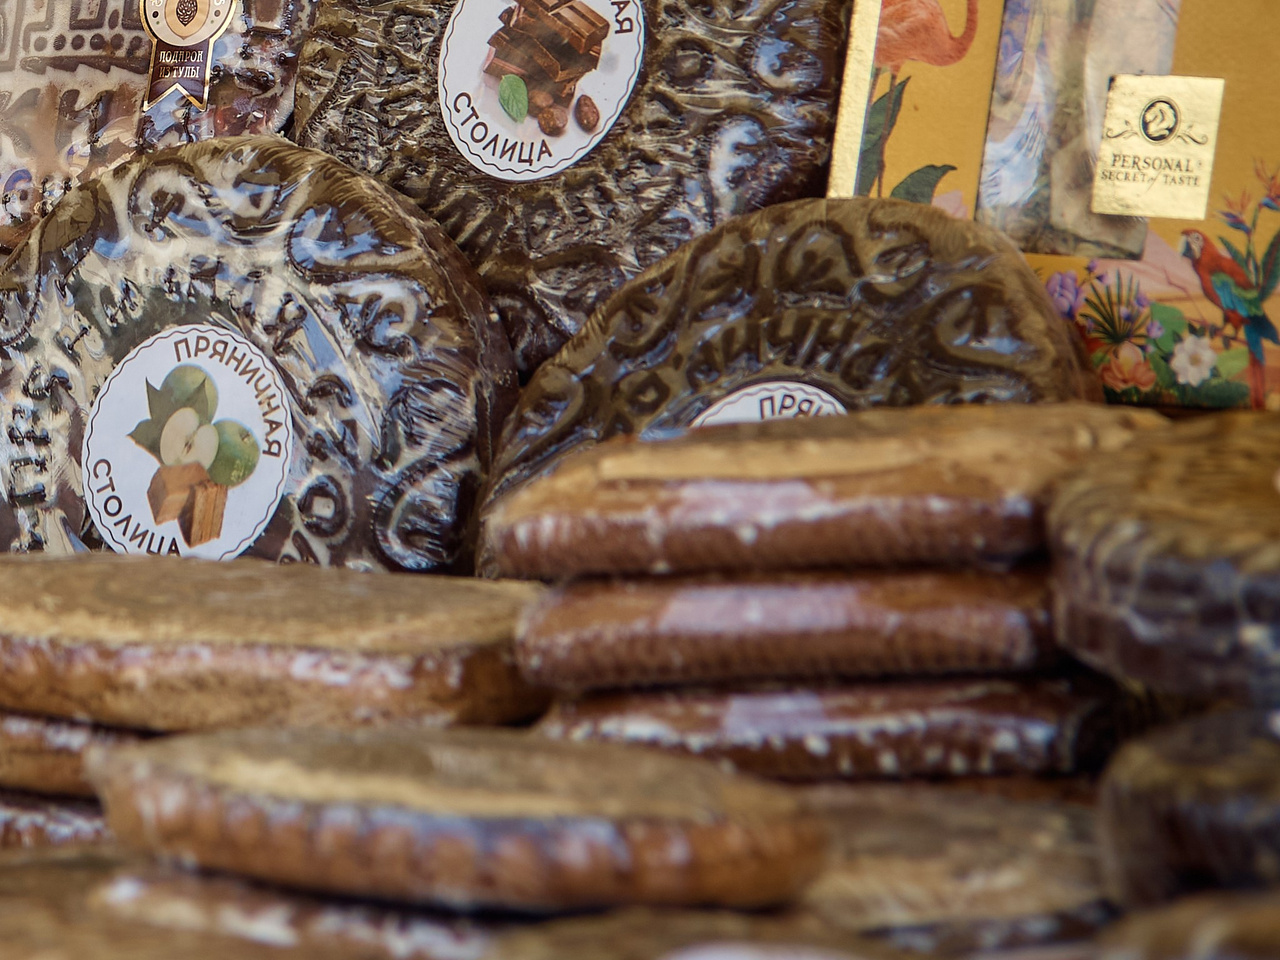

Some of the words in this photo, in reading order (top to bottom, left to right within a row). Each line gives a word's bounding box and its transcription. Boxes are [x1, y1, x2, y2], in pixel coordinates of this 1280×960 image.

[158, 49, 204, 64] ПОДАРОК
[172, 65, 200, 78] ТУЛЫ
[452, 90, 554, 166] СТОЛИЦА
[1111, 152, 1194, 173] PERSONAL
[1100, 169, 1147, 183] SECRET
[1163, 173, 1201, 188] TASTE
[173, 335, 283, 458] ПРЯНИЧНАЯ
[92, 458, 181, 557] СТОЛИЦА
